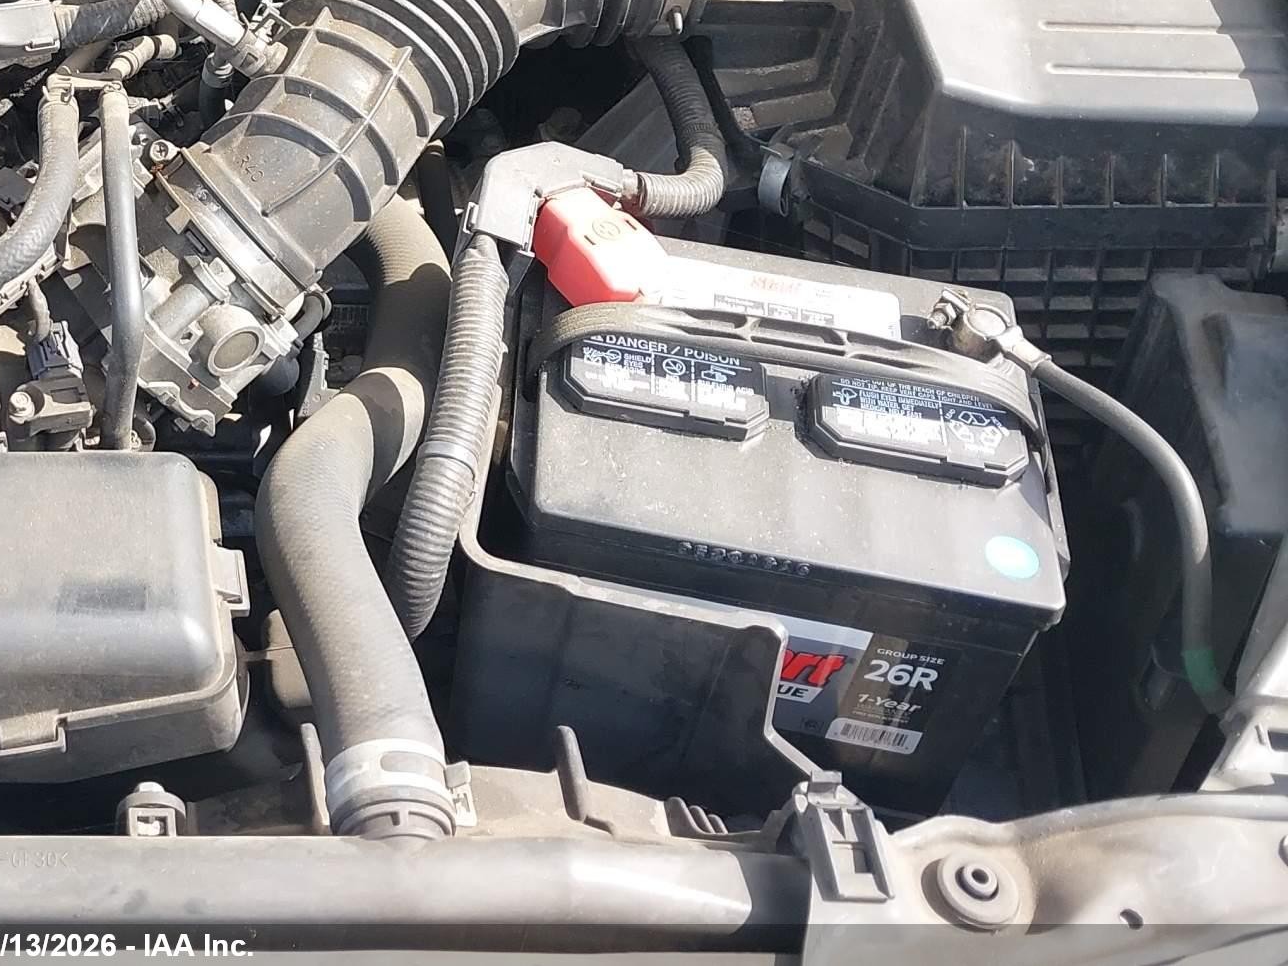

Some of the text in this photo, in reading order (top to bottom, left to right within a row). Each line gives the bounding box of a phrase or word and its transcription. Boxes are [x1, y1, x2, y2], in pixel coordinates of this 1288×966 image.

[605, 335, 668, 353] DANGER
[684, 348, 740, 366] POISON
[623, 353, 652, 363] SHIELD
[623, 359, 644, 369] EYES
[876, 648, 945, 665] GROUP SIZE
[863, 659, 939, 691] 26R
[857, 693, 922, 713] 1-Year
